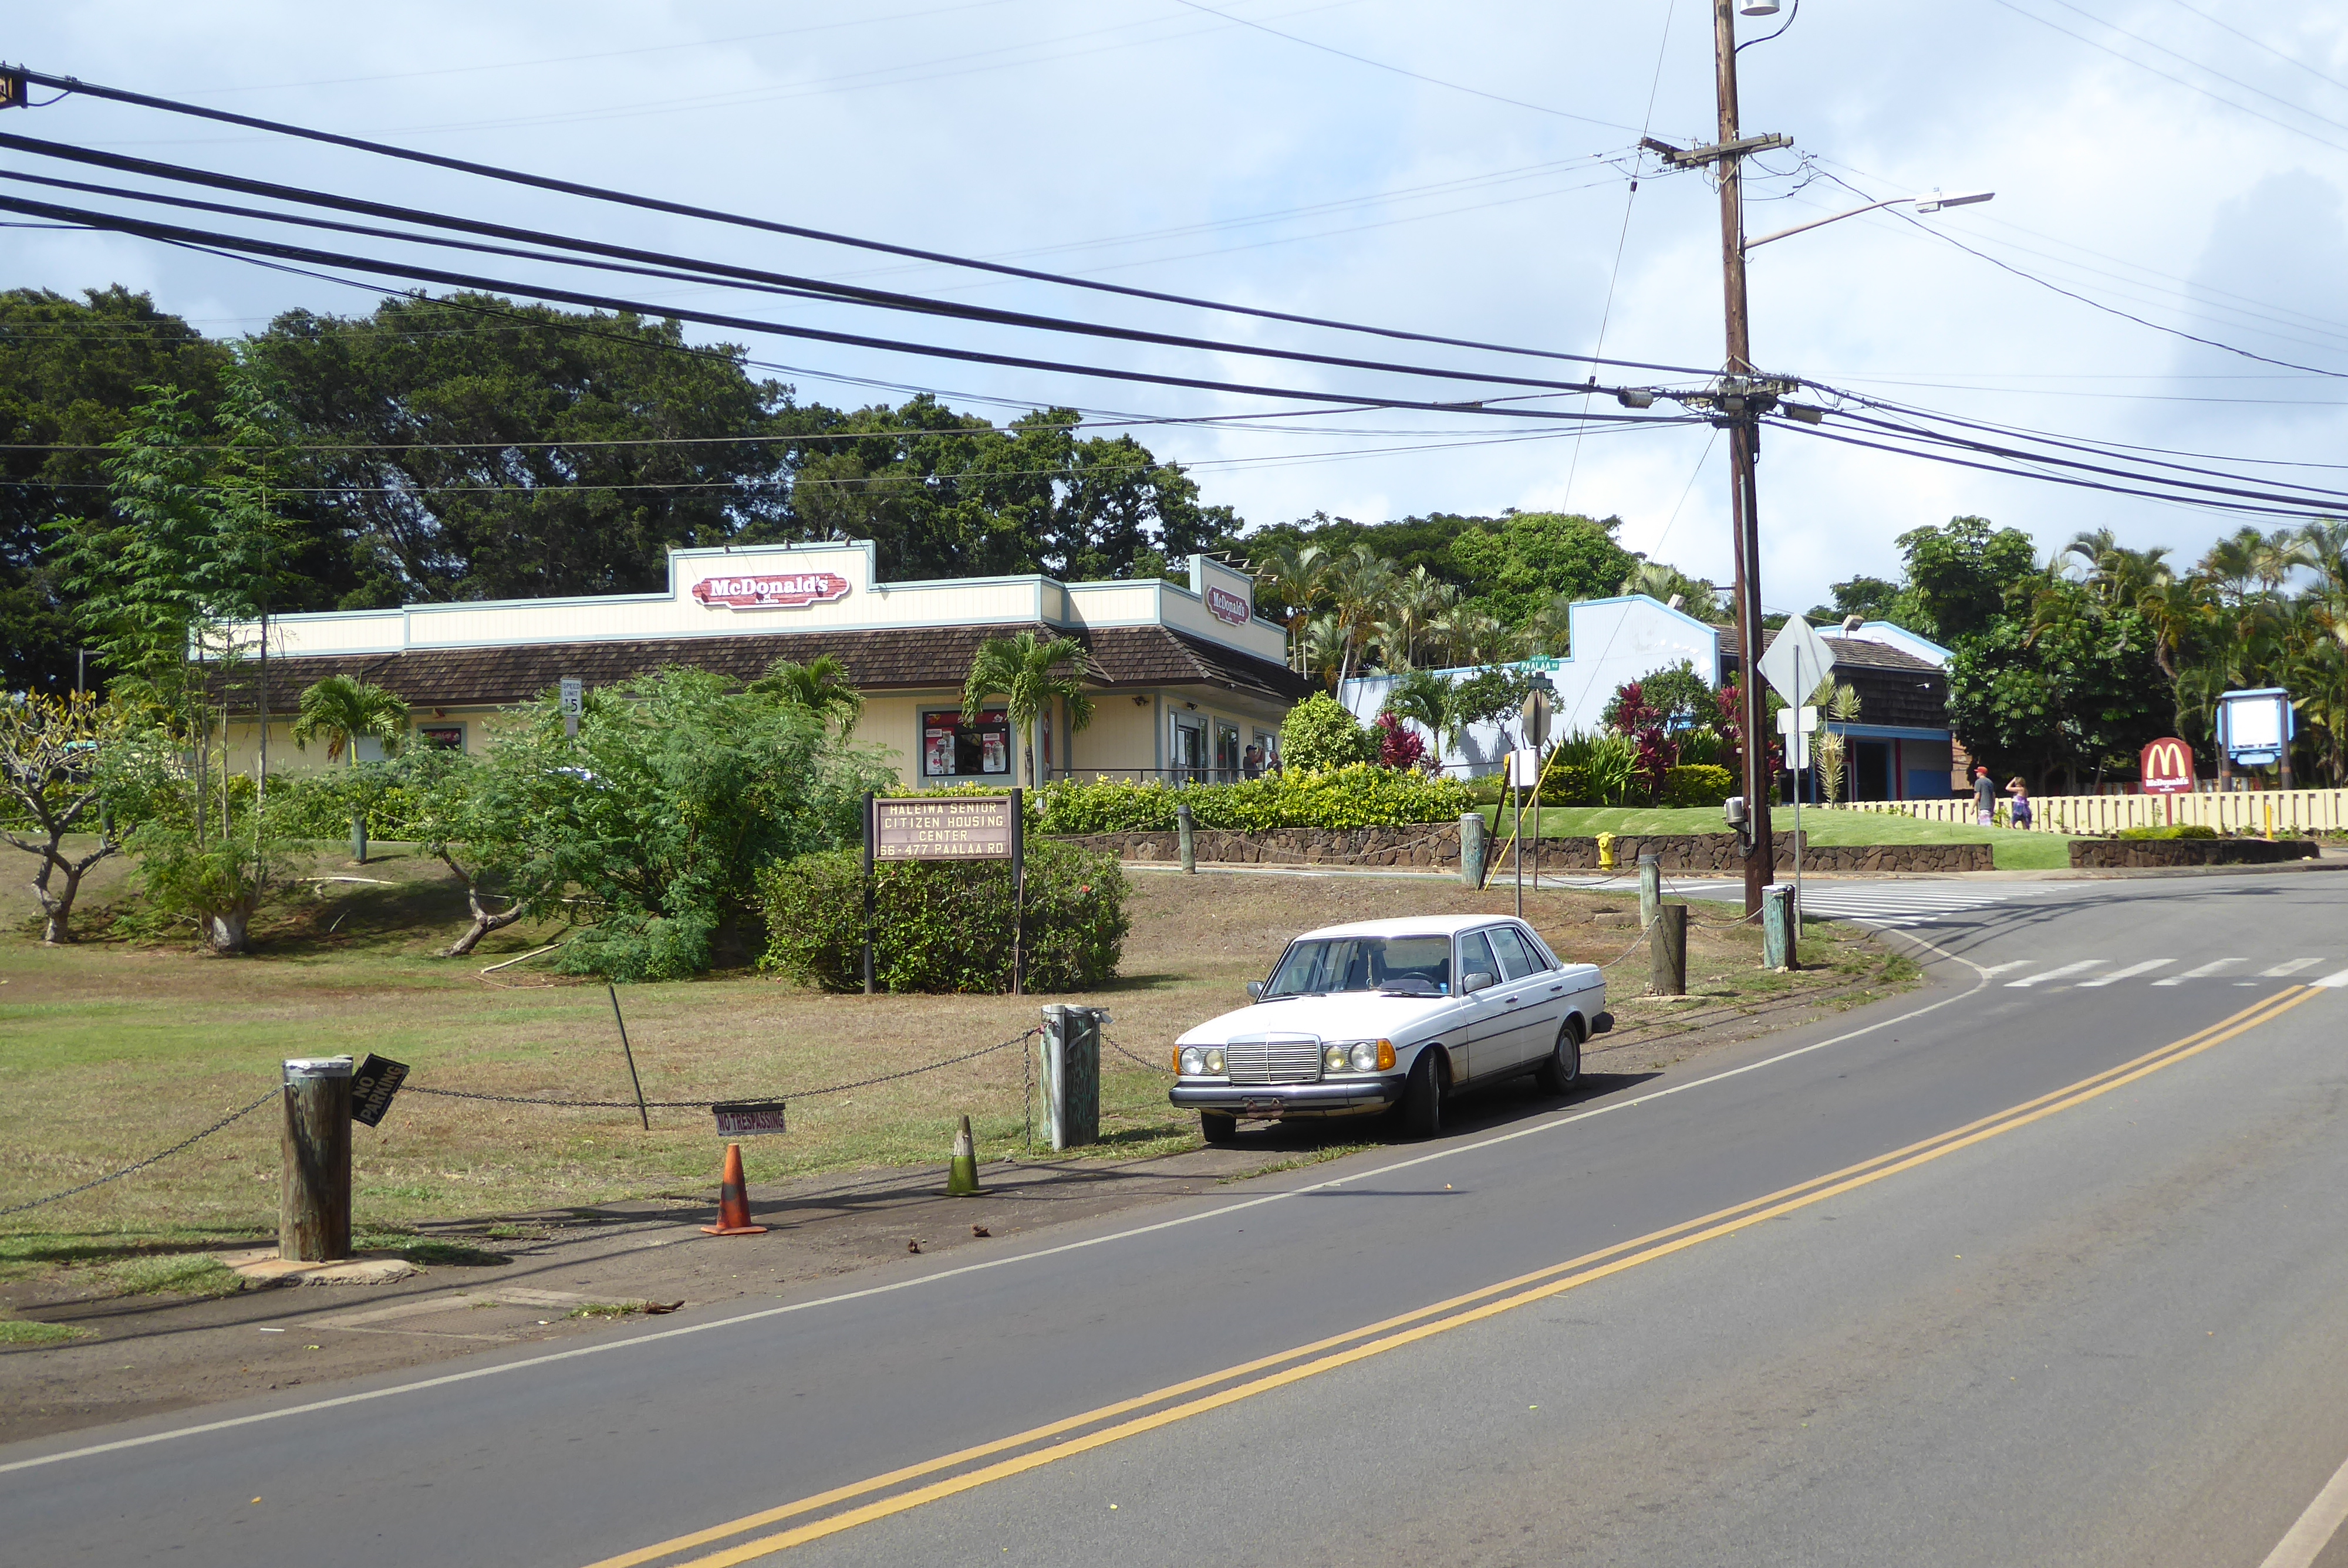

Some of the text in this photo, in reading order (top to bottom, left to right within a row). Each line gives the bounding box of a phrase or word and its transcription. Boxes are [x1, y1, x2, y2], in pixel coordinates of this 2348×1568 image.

[710, 576, 828, 596] McDonald's
[1213, 592, 1244, 617] McDonald's
[565, 698, 578, 712] 15
[2145, 776, 2189, 787] McDonald's
[890, 802, 997, 815] HALEIWA SENIOR
[885, 816, 1004, 829] CITIZEN HOUSING
[919, 830, 968, 841] CENTER
[880, 843, 1004, 856] 66-477 PAALAA RD
[352, 1076, 375, 1099] NO
[360, 1066, 404, 1122] PARKING
[718, 1111, 784, 1131] NO TRESPASSING
